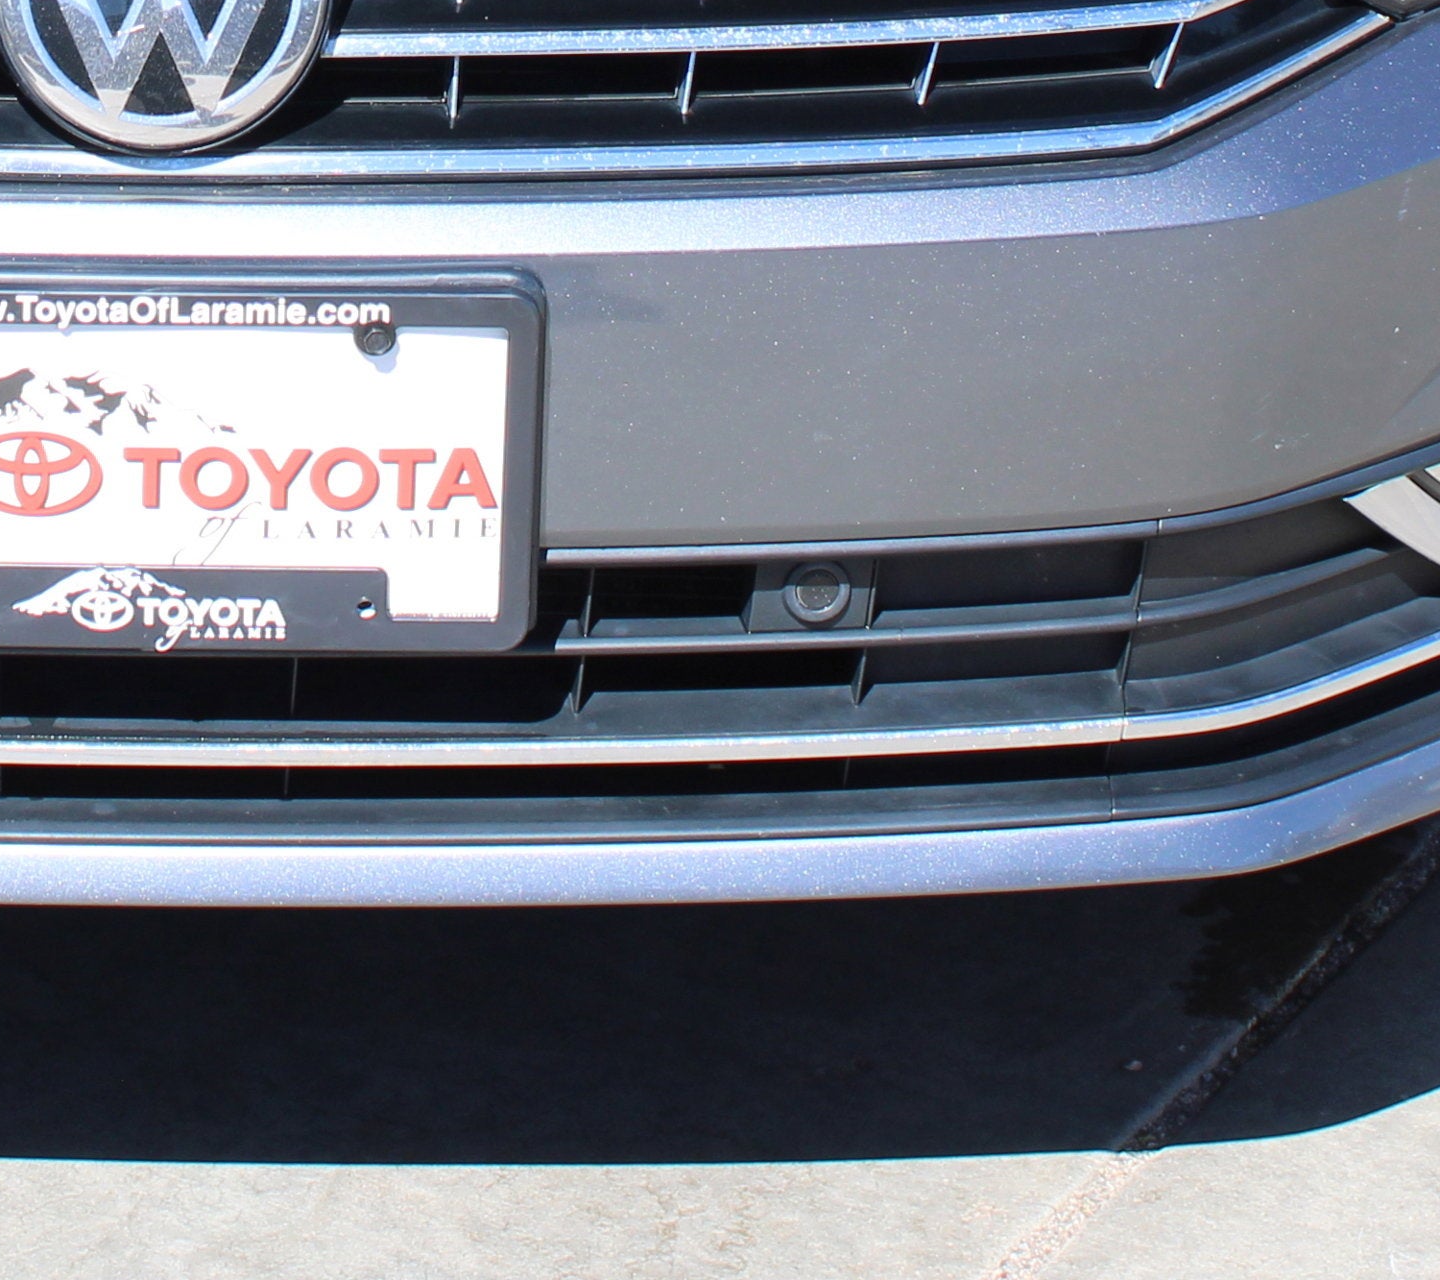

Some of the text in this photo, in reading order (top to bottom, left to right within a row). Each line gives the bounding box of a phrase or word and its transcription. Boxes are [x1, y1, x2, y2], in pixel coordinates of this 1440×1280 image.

[123, 446, 499, 512] TOYOTA
[171, 501, 498, 566] of LARAMIE
[136, 597, 287, 628] TOYOTA
[190, 626, 287, 640] LARAMIE
